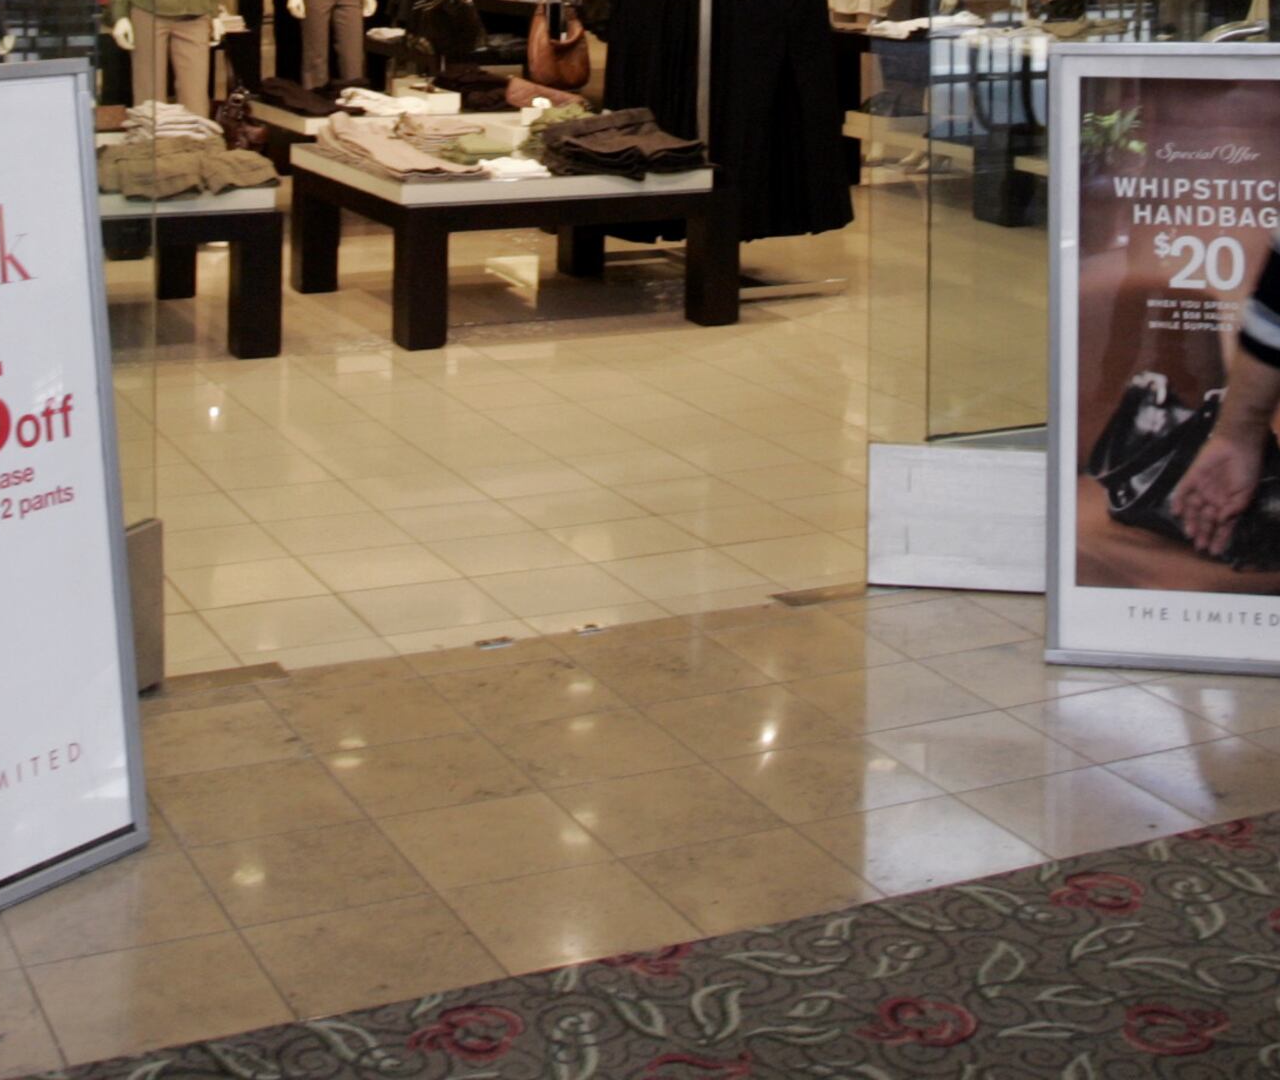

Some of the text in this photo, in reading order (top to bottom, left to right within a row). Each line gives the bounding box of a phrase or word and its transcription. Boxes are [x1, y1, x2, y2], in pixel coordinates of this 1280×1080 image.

[1155, 142, 1262, 164] Special Offer
[1132, 204, 1279, 229] HANDBAG
[1153, 231, 1246, 291] $20
[16, 393, 74, 449] off
[0, 498, 14, 520] 2
[19, 485, 75, 518] pants
[1128, 605, 1170, 621] THE
